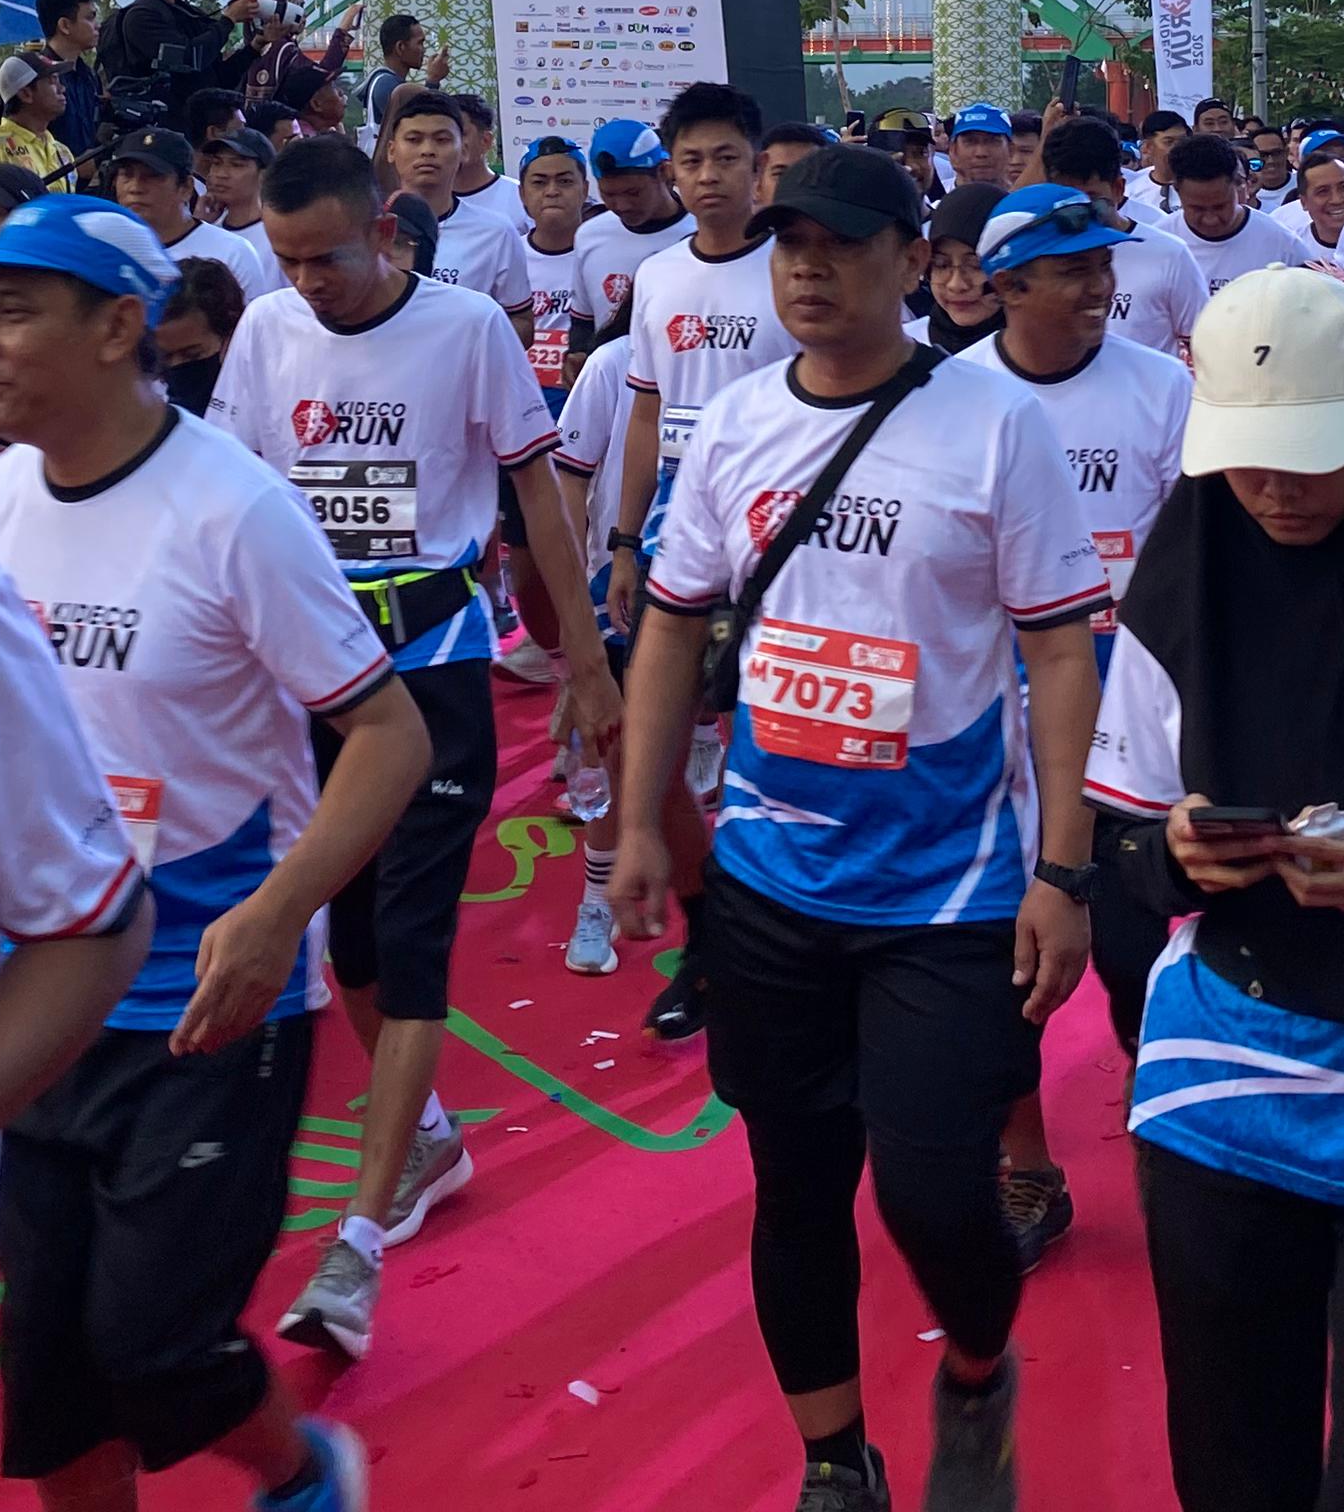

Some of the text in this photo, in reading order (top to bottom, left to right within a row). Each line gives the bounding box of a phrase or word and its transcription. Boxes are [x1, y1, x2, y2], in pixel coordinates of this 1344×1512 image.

[706, 315, 757, 328] KIDECO
[700, 326, 755, 350] RUN
[528, 349, 567, 366] 623
[1254, 344, 1271, 366] 7
[336, 401, 405, 417] KIDECO
[328, 416, 405, 446] RUN
[806, 511, 899, 557] RUN
[52, 602, 140, 628] KIDECO
[49, 623, 138, 671] RUN
[747, 658, 874, 720] M 7073
